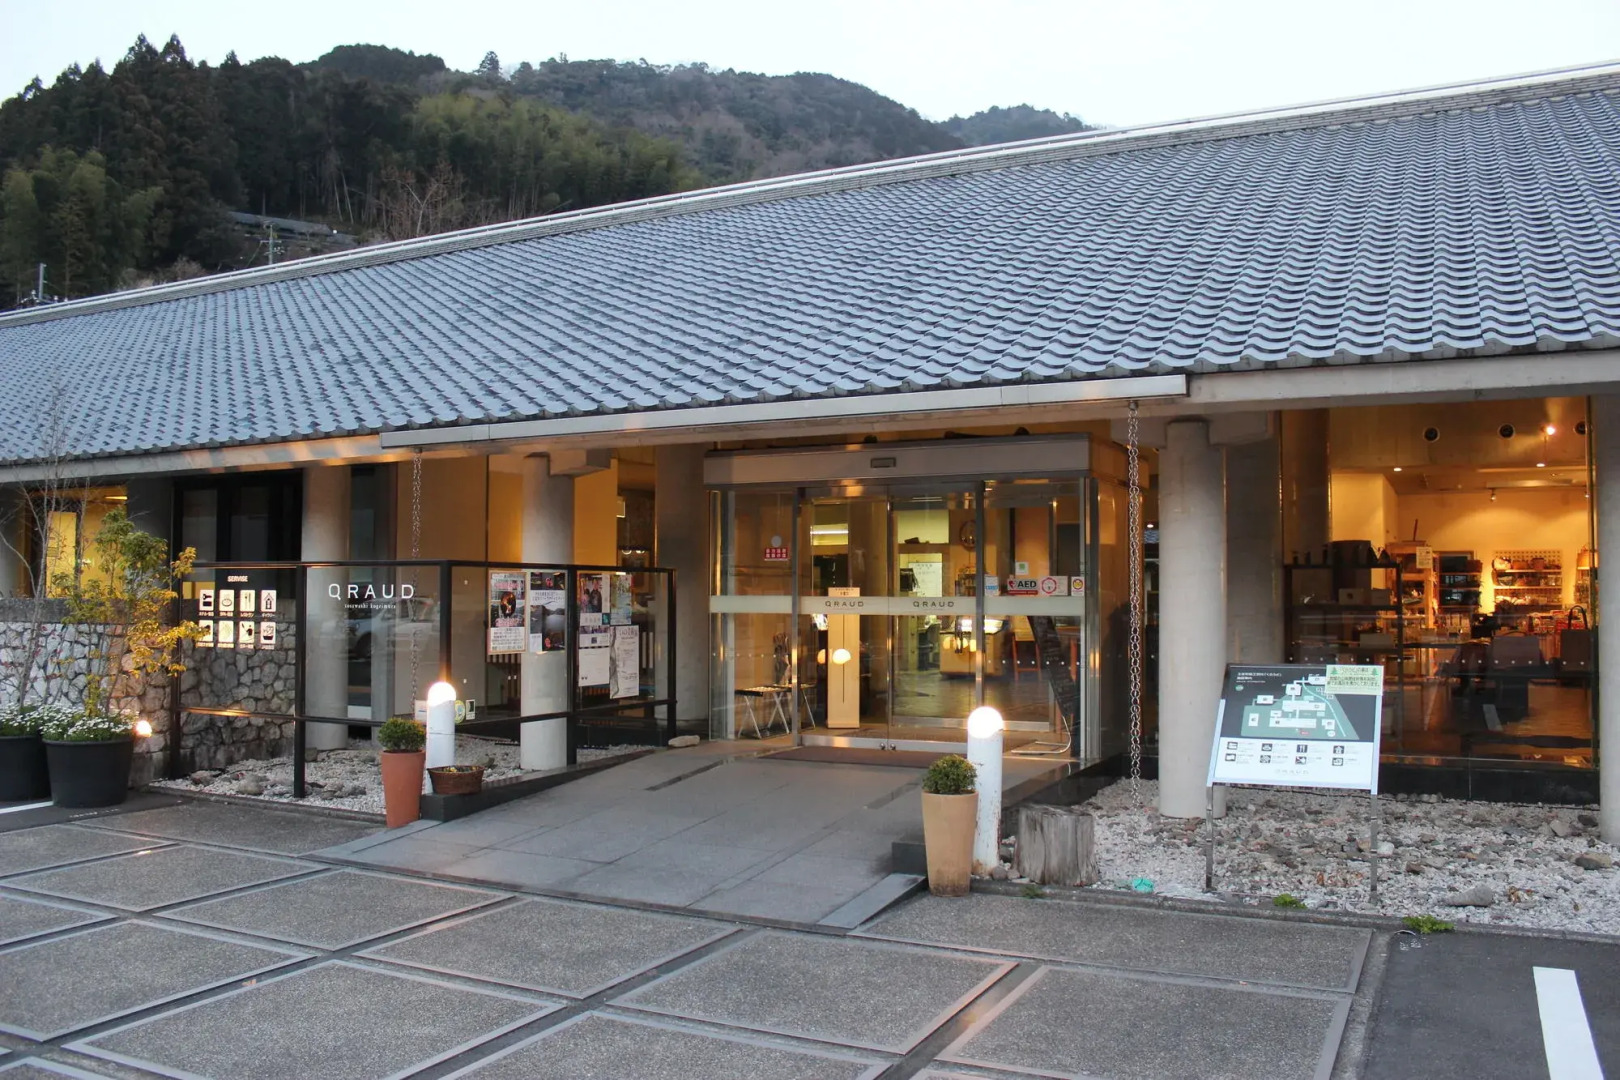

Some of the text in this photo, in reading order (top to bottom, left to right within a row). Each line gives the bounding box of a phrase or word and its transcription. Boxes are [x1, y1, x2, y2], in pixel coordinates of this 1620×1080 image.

[1017, 580, 1037, 588] AED
[328, 583, 414, 600] QRAUD
[824, 600, 865, 608] QRAUD
[912, 600, 955, 608] QRAUD
